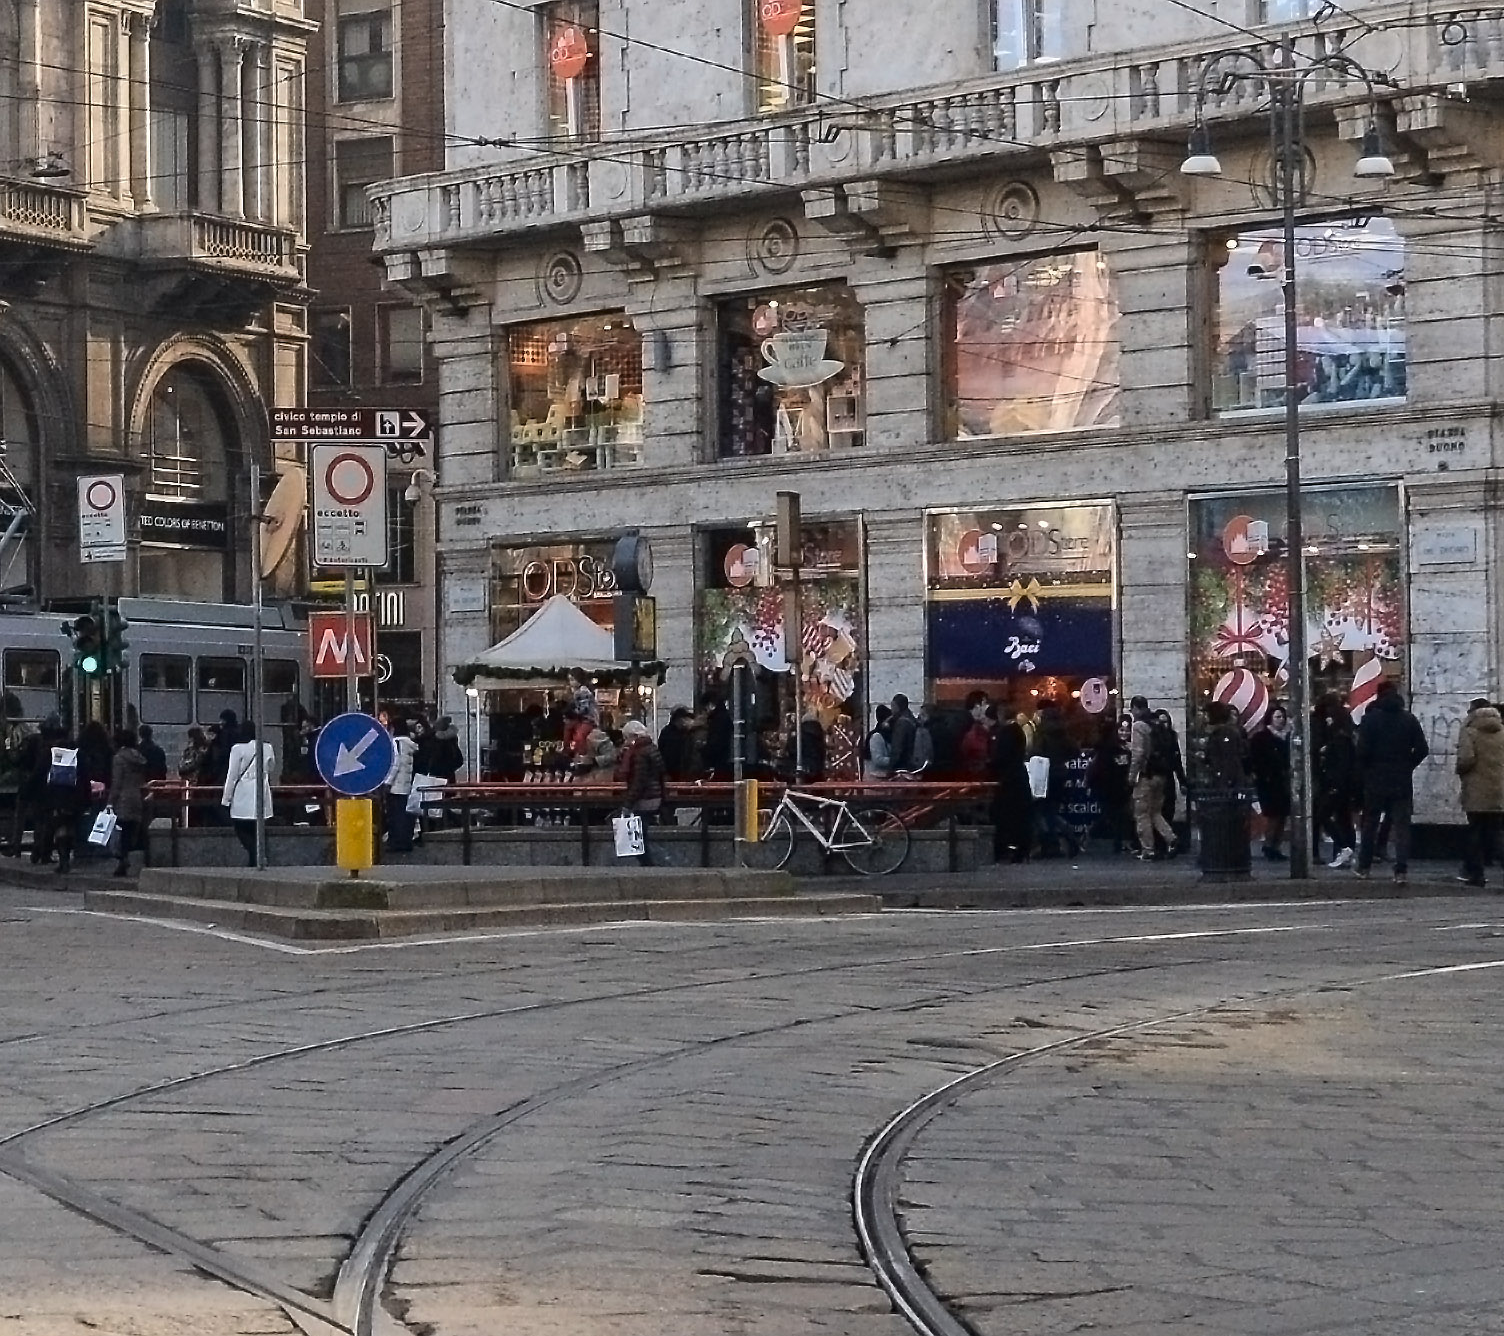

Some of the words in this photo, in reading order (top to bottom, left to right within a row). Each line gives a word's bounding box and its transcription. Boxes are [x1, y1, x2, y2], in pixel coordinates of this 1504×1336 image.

[274, 412, 306, 421] civico
[309, 412, 348, 423] tempio
[351, 412, 362, 421] di
[275, 426, 296, 435] San
[301, 425, 362, 435] Sebastiano
[317, 509, 360, 517] eccetto
[155, 516, 180, 528] COLORS
[181, 518, 191, 529] OF
[192, 520, 224, 532] BENETTON
[316, 629, 365, 663] M
[1004, 636, 1040, 659] Baci
